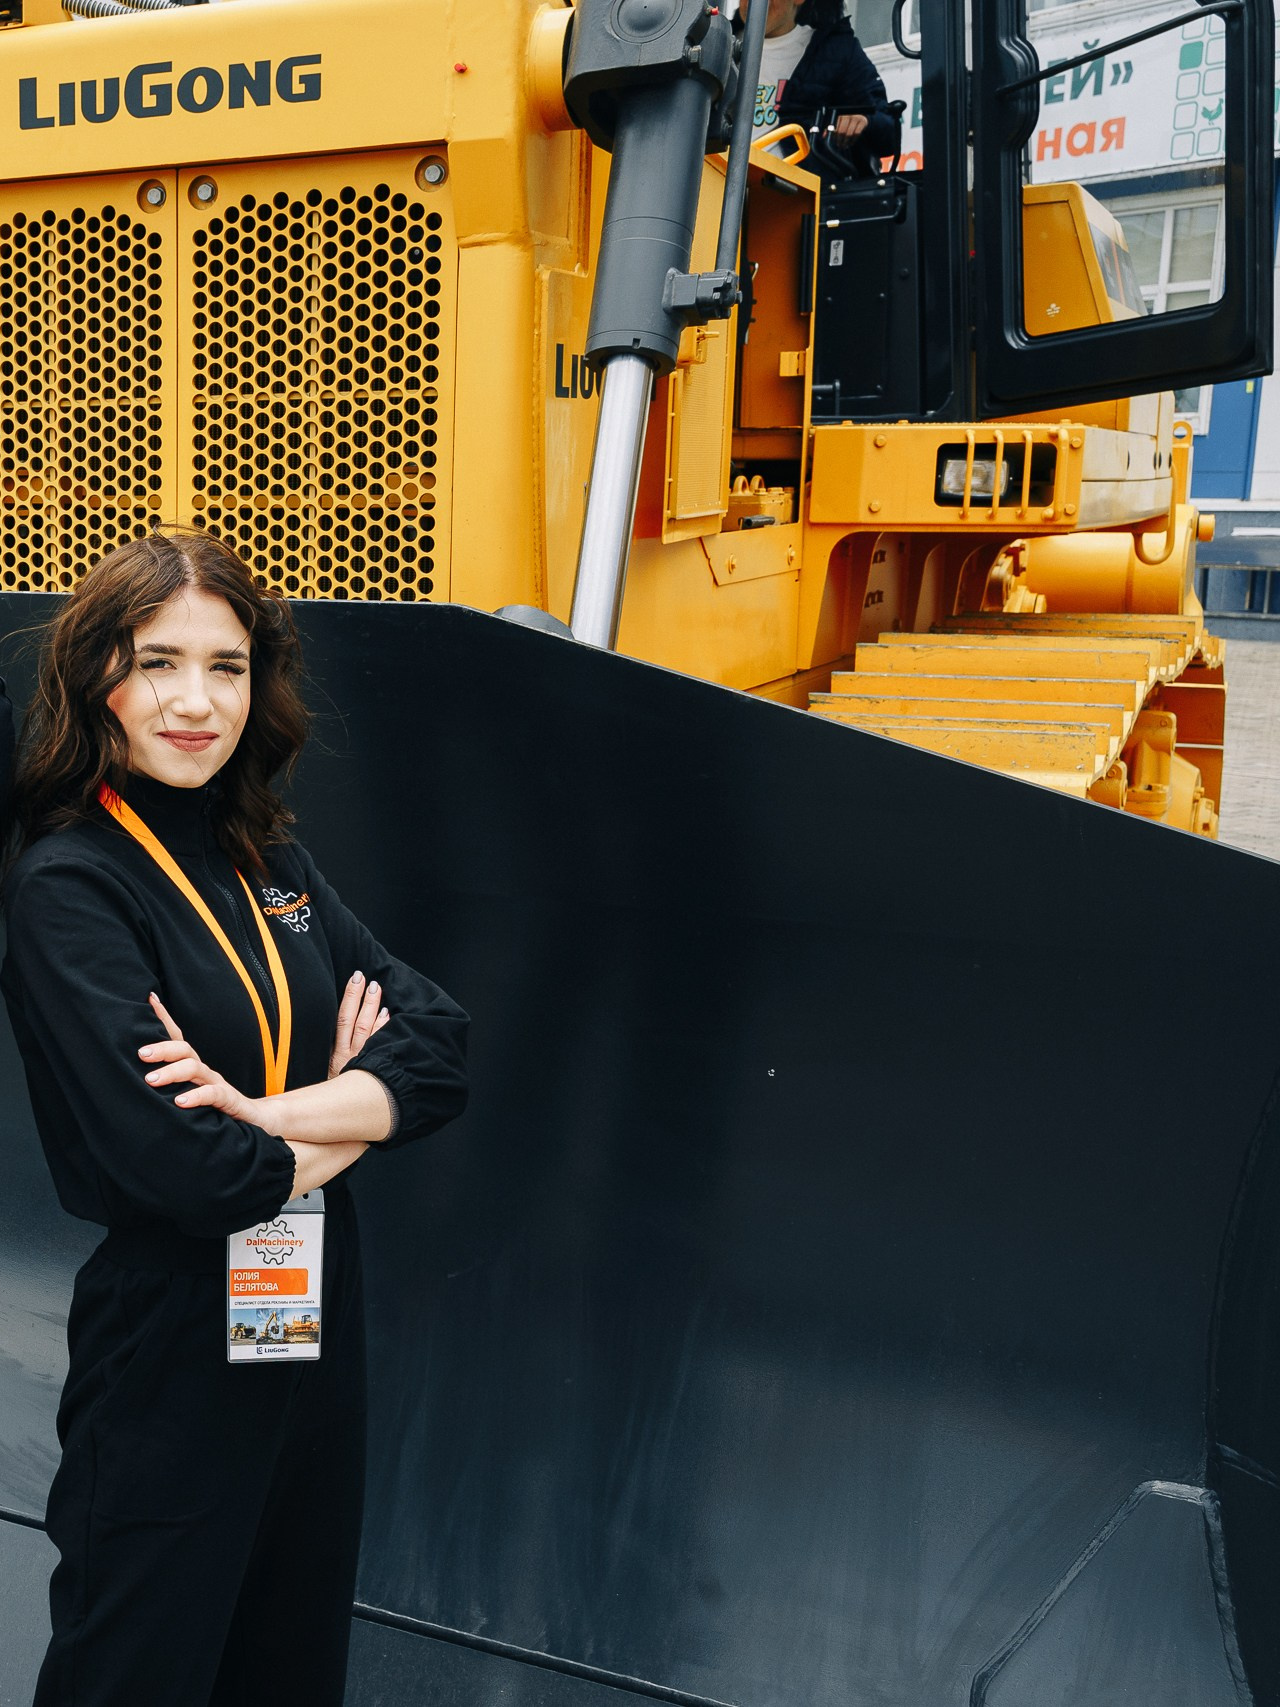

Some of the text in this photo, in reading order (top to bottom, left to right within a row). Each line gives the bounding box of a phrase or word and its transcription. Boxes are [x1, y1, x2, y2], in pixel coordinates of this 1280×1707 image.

[246, 1238, 304, 1247] DalMachinery
[233, 1271, 260, 1281] ЮЛИЯ
[233, 1282, 279, 1292] БЕЛЯТОВА
